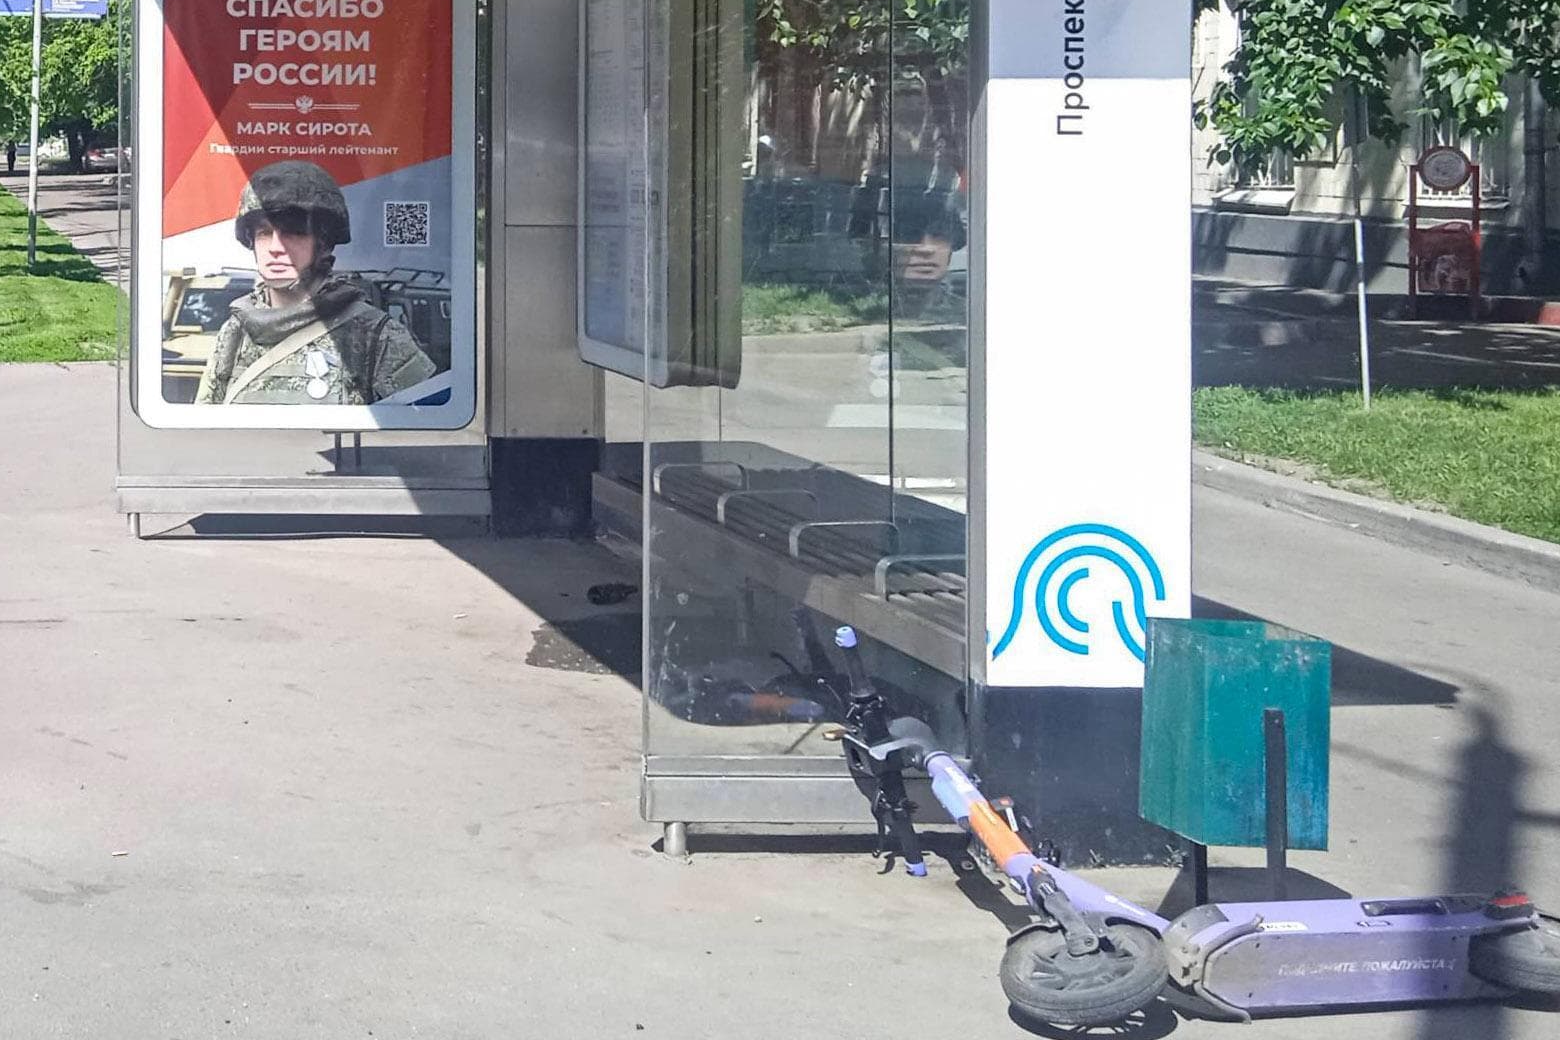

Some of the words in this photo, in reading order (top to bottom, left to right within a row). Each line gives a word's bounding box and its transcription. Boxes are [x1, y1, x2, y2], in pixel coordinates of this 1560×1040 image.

[238, 29, 371, 53] ГЕРОЯМ
[232, 63, 377, 86] РОССИИ!
[236, 122, 291, 136] МАРК
[295, 122, 372, 136] СИРОТА
[208, 143, 265, 156] Гвардии
[267, 144, 326, 157] старший
[328, 143, 399, 156] лейтенант
